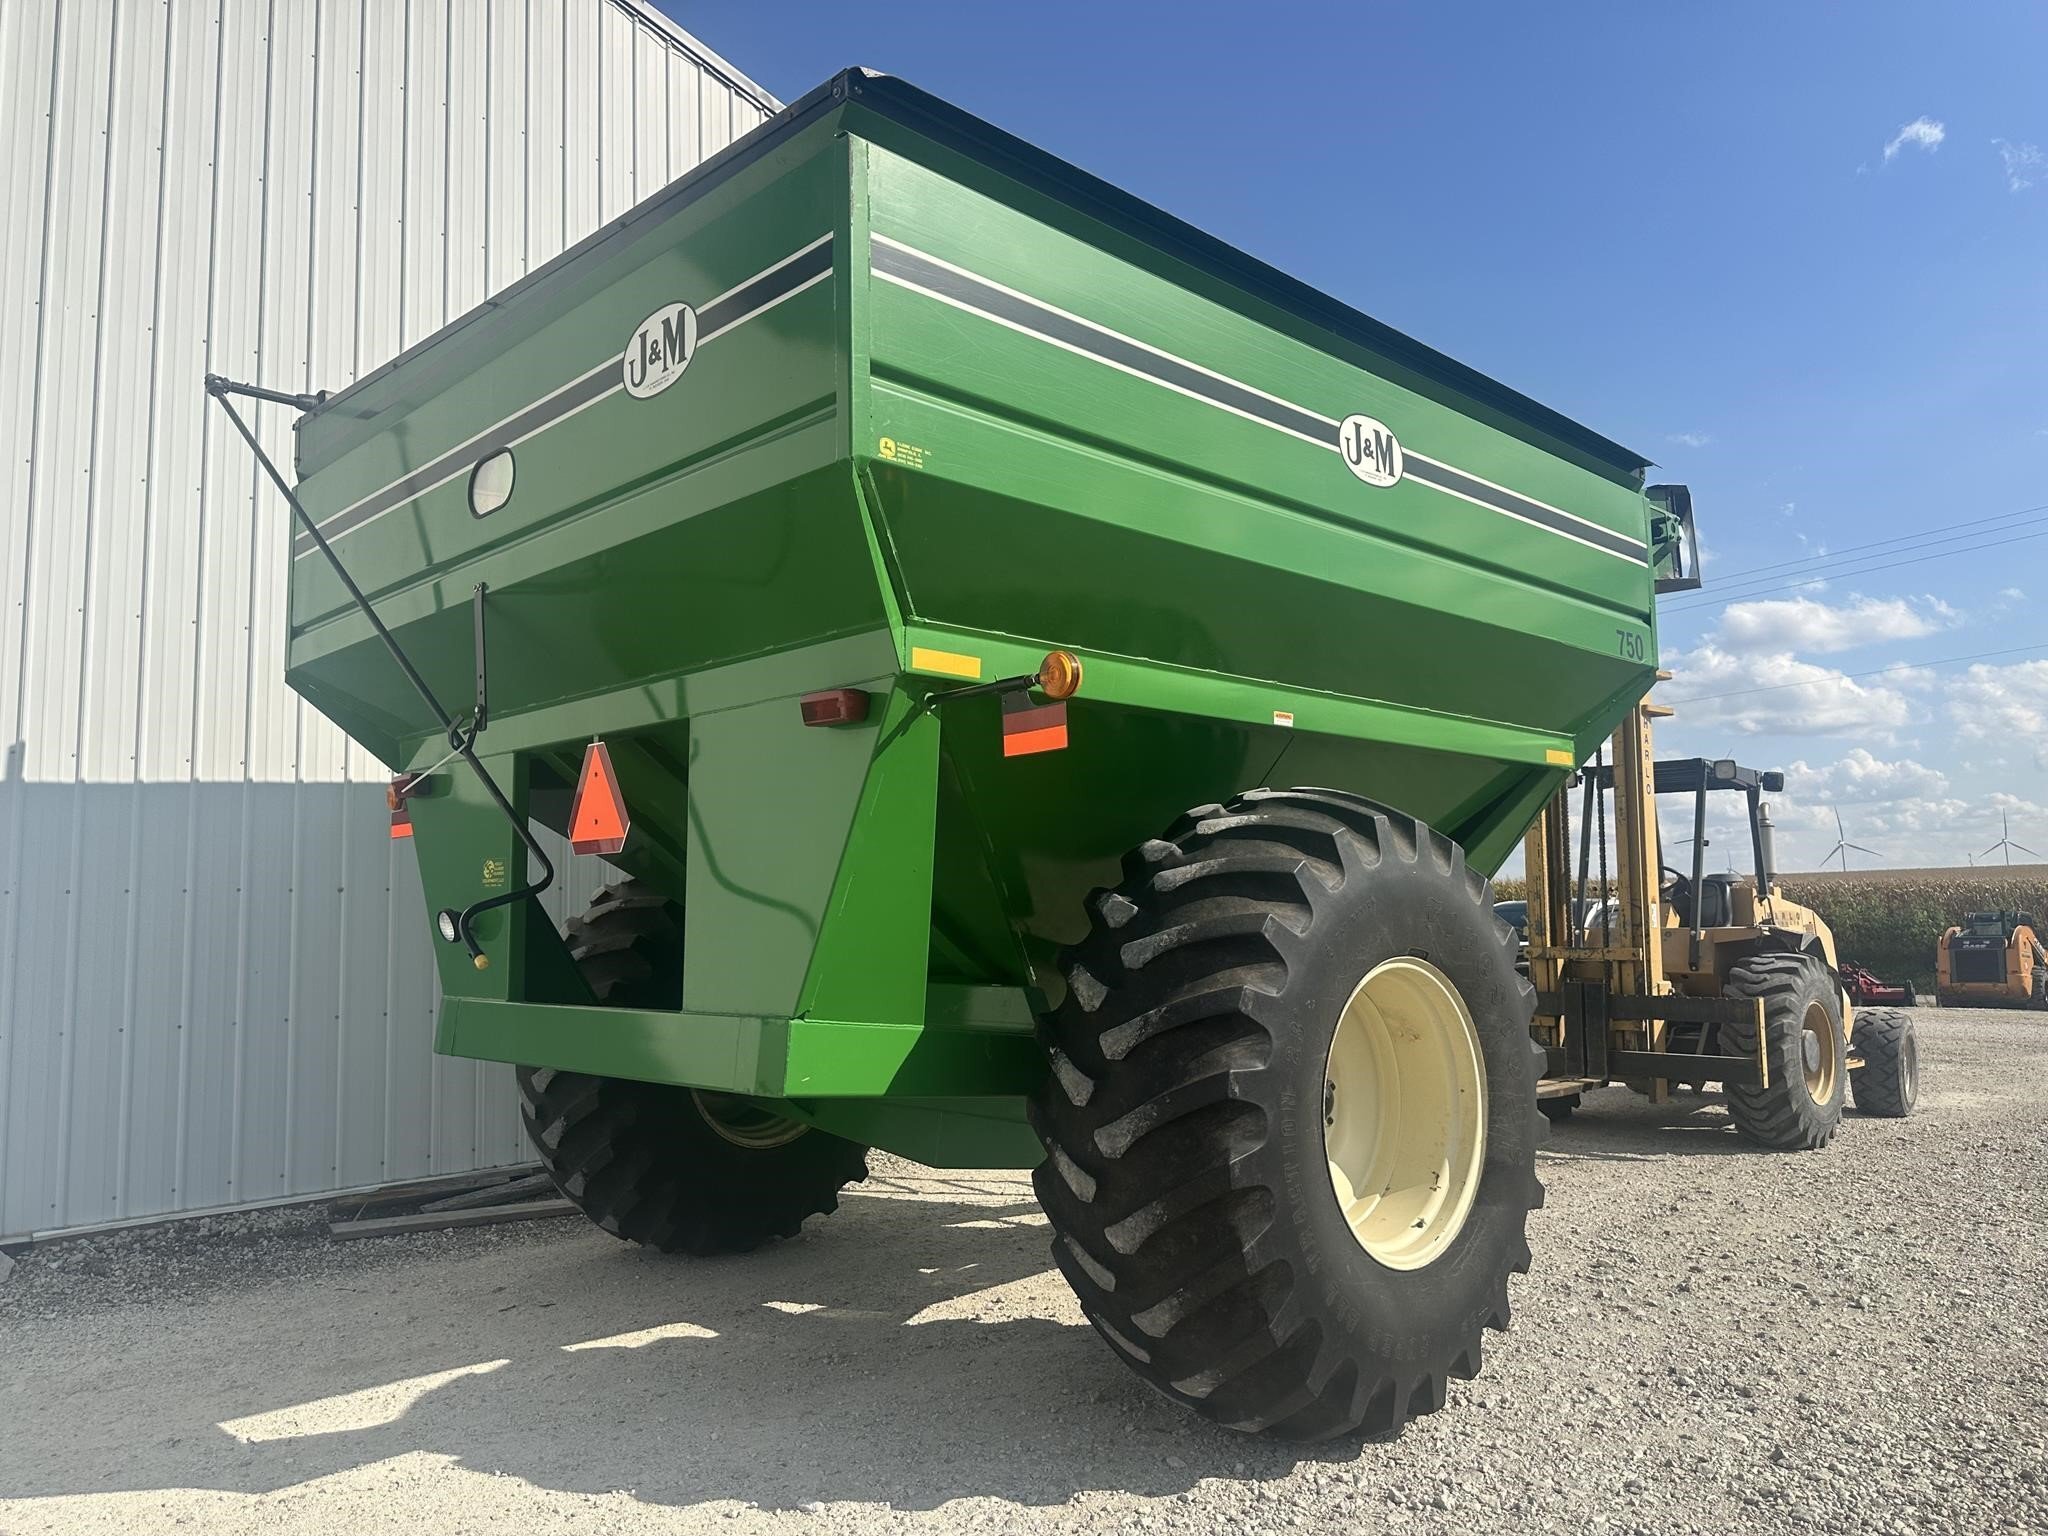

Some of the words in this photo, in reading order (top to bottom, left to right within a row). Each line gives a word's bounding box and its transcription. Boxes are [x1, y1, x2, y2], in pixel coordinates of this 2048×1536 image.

[628, 306, 687, 388] J&M
[1345, 421, 1395, 478] J&M
[1616, 629, 1644, 661] 750
[1643, 718, 1652, 795] HARLO
